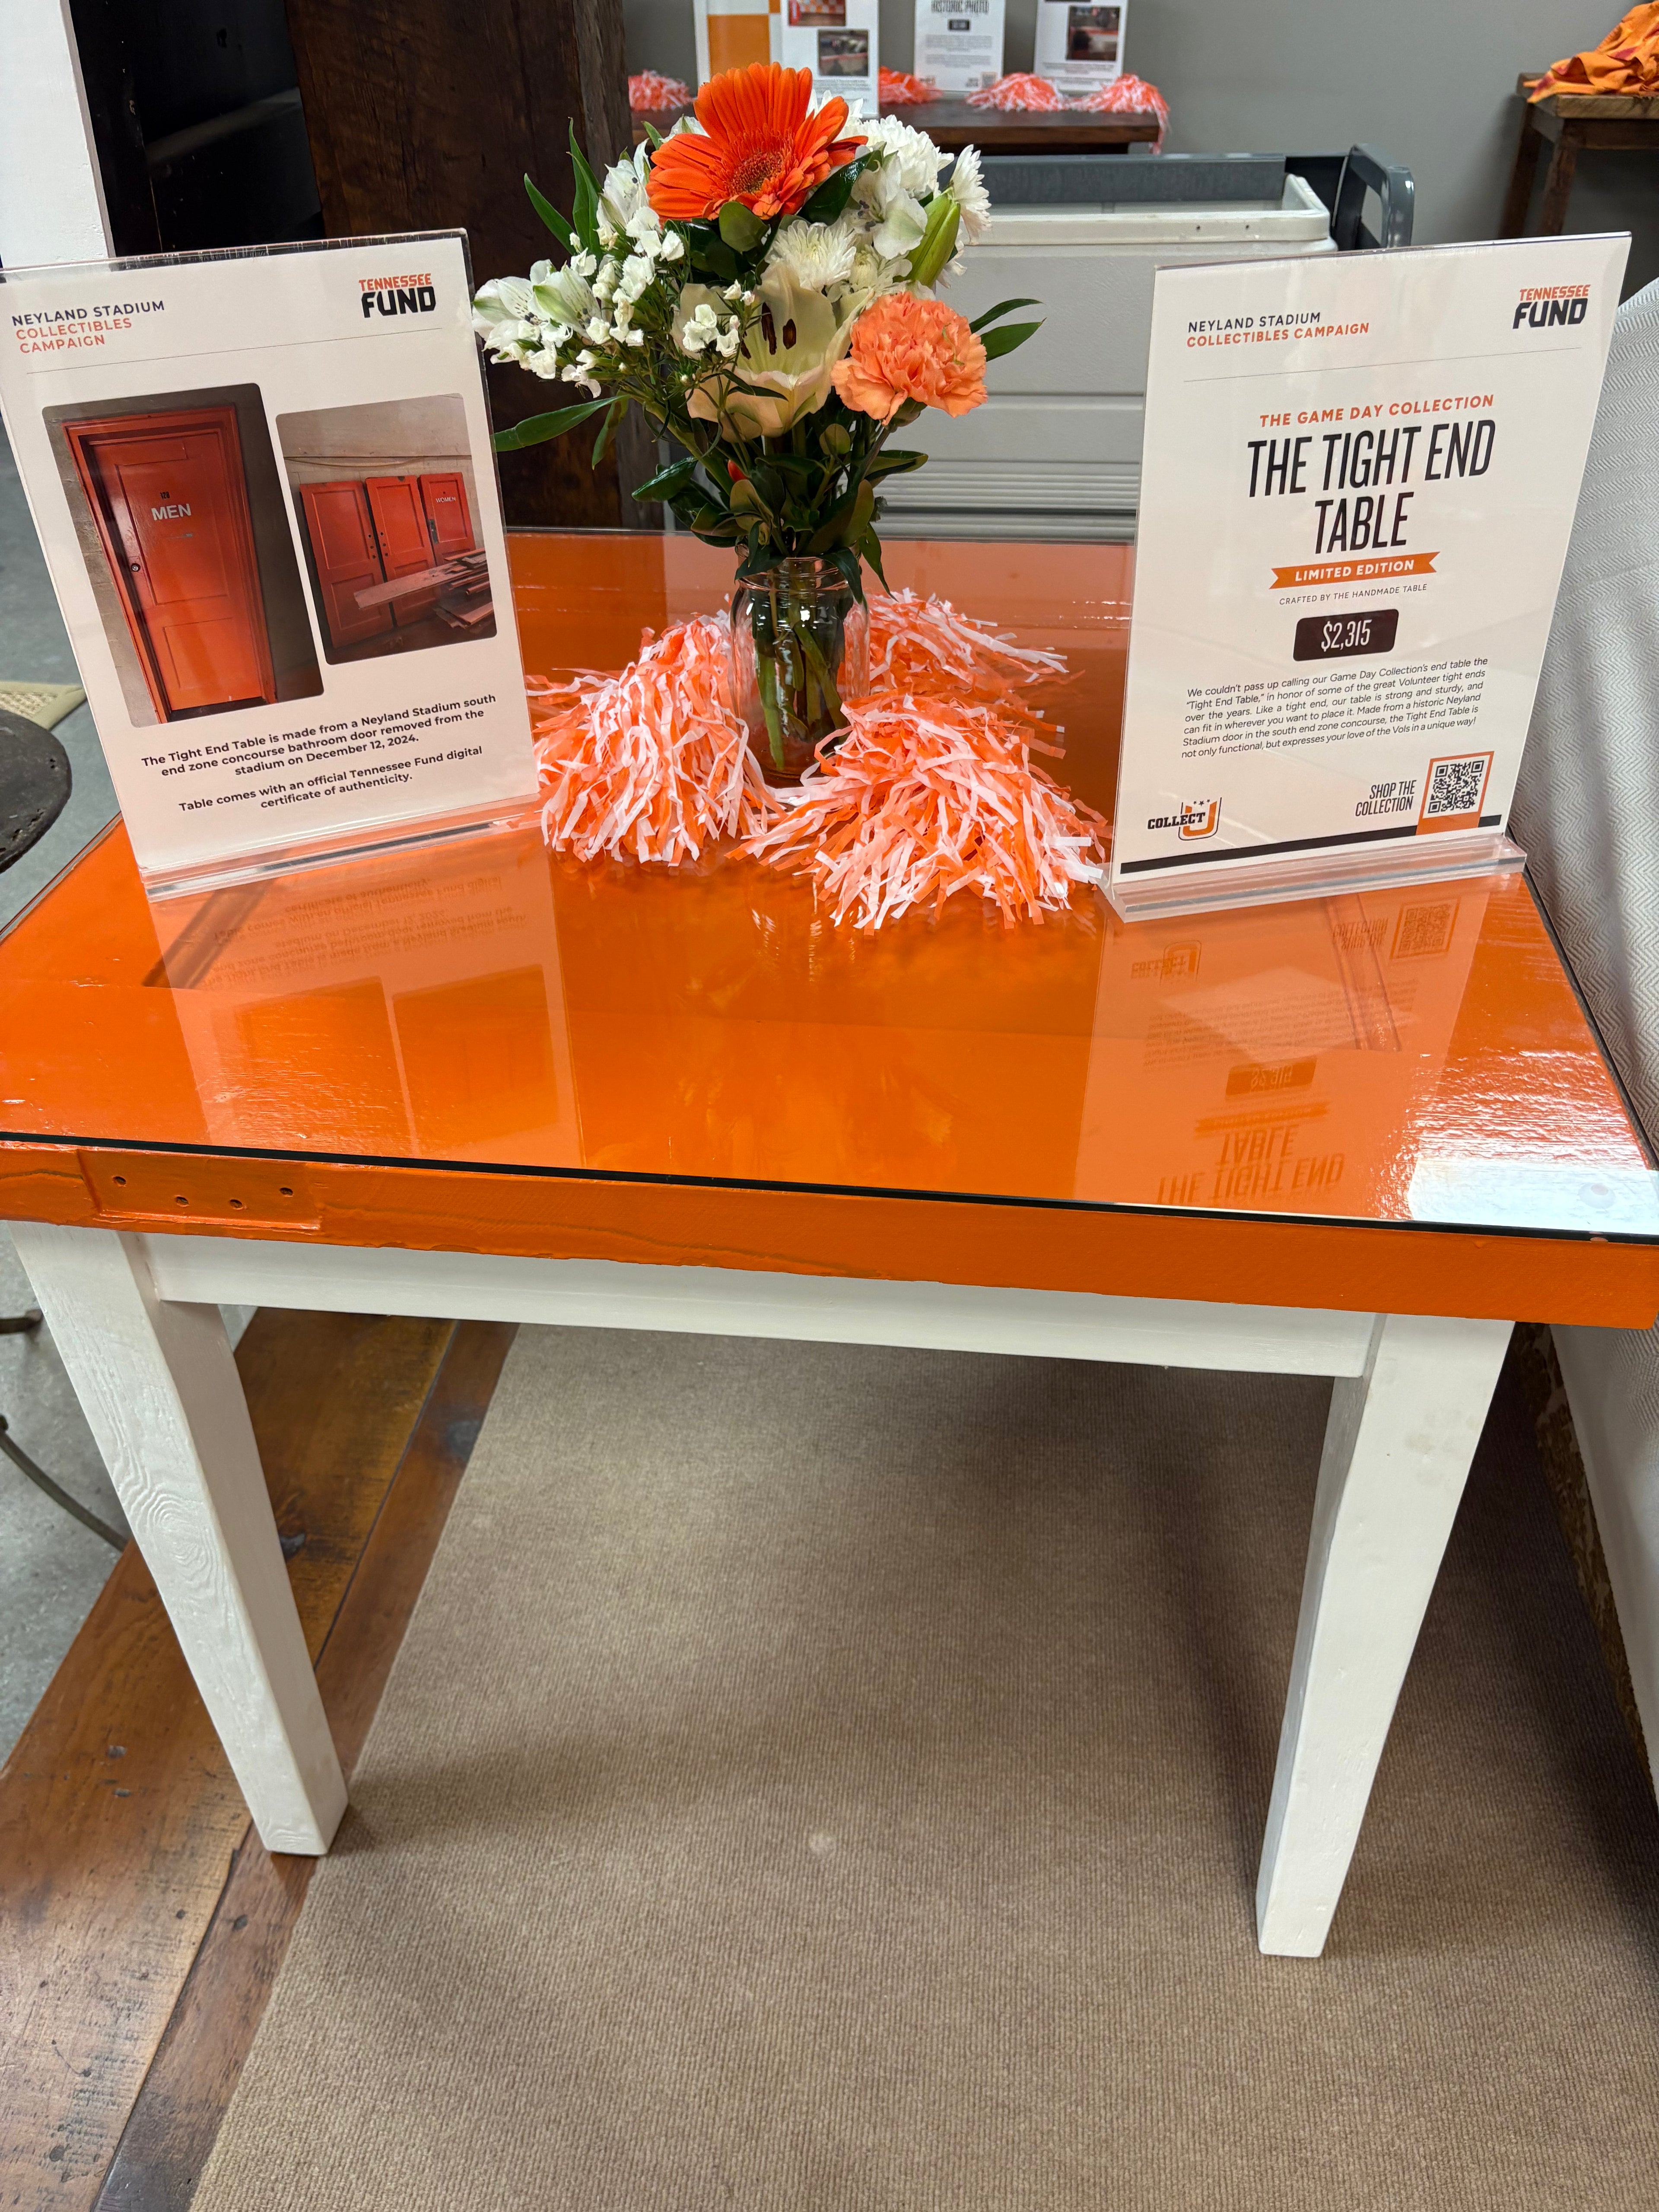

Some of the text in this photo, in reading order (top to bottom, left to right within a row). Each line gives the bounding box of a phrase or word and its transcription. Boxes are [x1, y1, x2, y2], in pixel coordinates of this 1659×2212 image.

[358, 273, 432, 292] TENNESSEE
[1519, 284, 1591, 301] TENNESSEE
[12, 300, 165, 326] NEYLAND STADIUM
[361, 286, 436, 318] FUND
[1513, 298, 1588, 329] FUND
[16, 318, 132, 340] COLLECTIBLES
[1187, 322, 1369, 347] COLLECTIBLES CAMPAIGN
[1188, 312, 1320, 333] NEYLAND STADIUM
[20, 334, 105, 353] CAMPAIGN
[1260, 394, 1494, 427] THE GAME DAY COLLECTION
[1247, 419, 1496, 498] THE TIGHT END
[151, 503, 191, 521] MEN
[1315, 491, 1414, 554] TABLE
[1295, 559, 1414, 582] LIMITED EDITION
[1279, 584, 1427, 605] CRAFTED BY THE HANDMADE TABLE
[1321, 620, 1372, 652] $2,315
[1186, 669, 1486, 711] "Tight End Table," in honor of some of the great Volunteer tight ends
[1187, 657, 1488, 698] We couldn't pass up calling our Game Day Collection's end table the
[1202, 723, 1212, 732] fit
[1214, 722, 1222, 731] in
[1224, 719, 1266, 730] wherever
[1267, 717, 1284, 727] you
[1286, 712, 1308, 723] want
[1321, 710, 1345, 721] place
[1357, 705, 1381, 715] Made
[1383, 702, 1404, 712] from
[1413, 697, 1444, 709] historic
[1446, 693, 1481, 706] Neyland
[1208, 710, 1223, 720] the
[1226, 709, 1252, 720] years.
[1256, 705, 1274, 714] Like
[1286, 701, 1306, 712] tight
[1309, 698, 1328, 709] end,
[1350, 694, 1372, 704] table
[1375, 693, 1382, 701] is
[1385, 691, 1413, 700] strong
[1416, 686, 1433, 696] and
[1435, 683, 1464, 694] sturdy,
[1467, 681, 1484, 690] and
[141, 756, 166, 766] The
[168, 749, 203, 762] Tight
[205, 742, 230, 755] End
[231, 737, 266, 750] Table
[269, 734, 280, 744] is
[282, 728, 316, 741] made
[319, 723, 348, 734] from
[361, 709, 410, 726] Neyland
[412, 702, 461, 717] Stadium
[464, 694, 496, 707] south
[1182, 750, 1197, 759] not
[1198, 747, 1217, 757] only
[1218, 741, 1265, 755] functional,
[1266, 740, 1281, 750] but
[1282, 736, 1325, 747] expresses
[1325, 733, 1346, 744] your
[1347, 731, 1365, 739] love
[1366, 728, 1376, 737] of
[1377, 727, 1391, 736] the
[1392, 725, 1411, 734] Vols
[1411, 723, 1419, 732] in
[1427, 720, 1456, 730] unique
[1457, 716, 1476, 727] way!
[1183, 705, 1478, 746] Stadium door in the south end zone concourse, the Tight End Table is
[162, 710, 484, 776] end zone concourse bathroom door removed from the
[235, 734, 419, 775] stadium on December 12, 2024.
[178, 746, 482, 811] Table comes with an official Tennessee Fund digital
[261, 773, 413, 808] certificate of authenticity.
[1369, 780, 1417, 800] SHOP THE
[1147, 812, 1205, 829] COLLECT
[1355, 795, 1414, 817] COLLECTION
